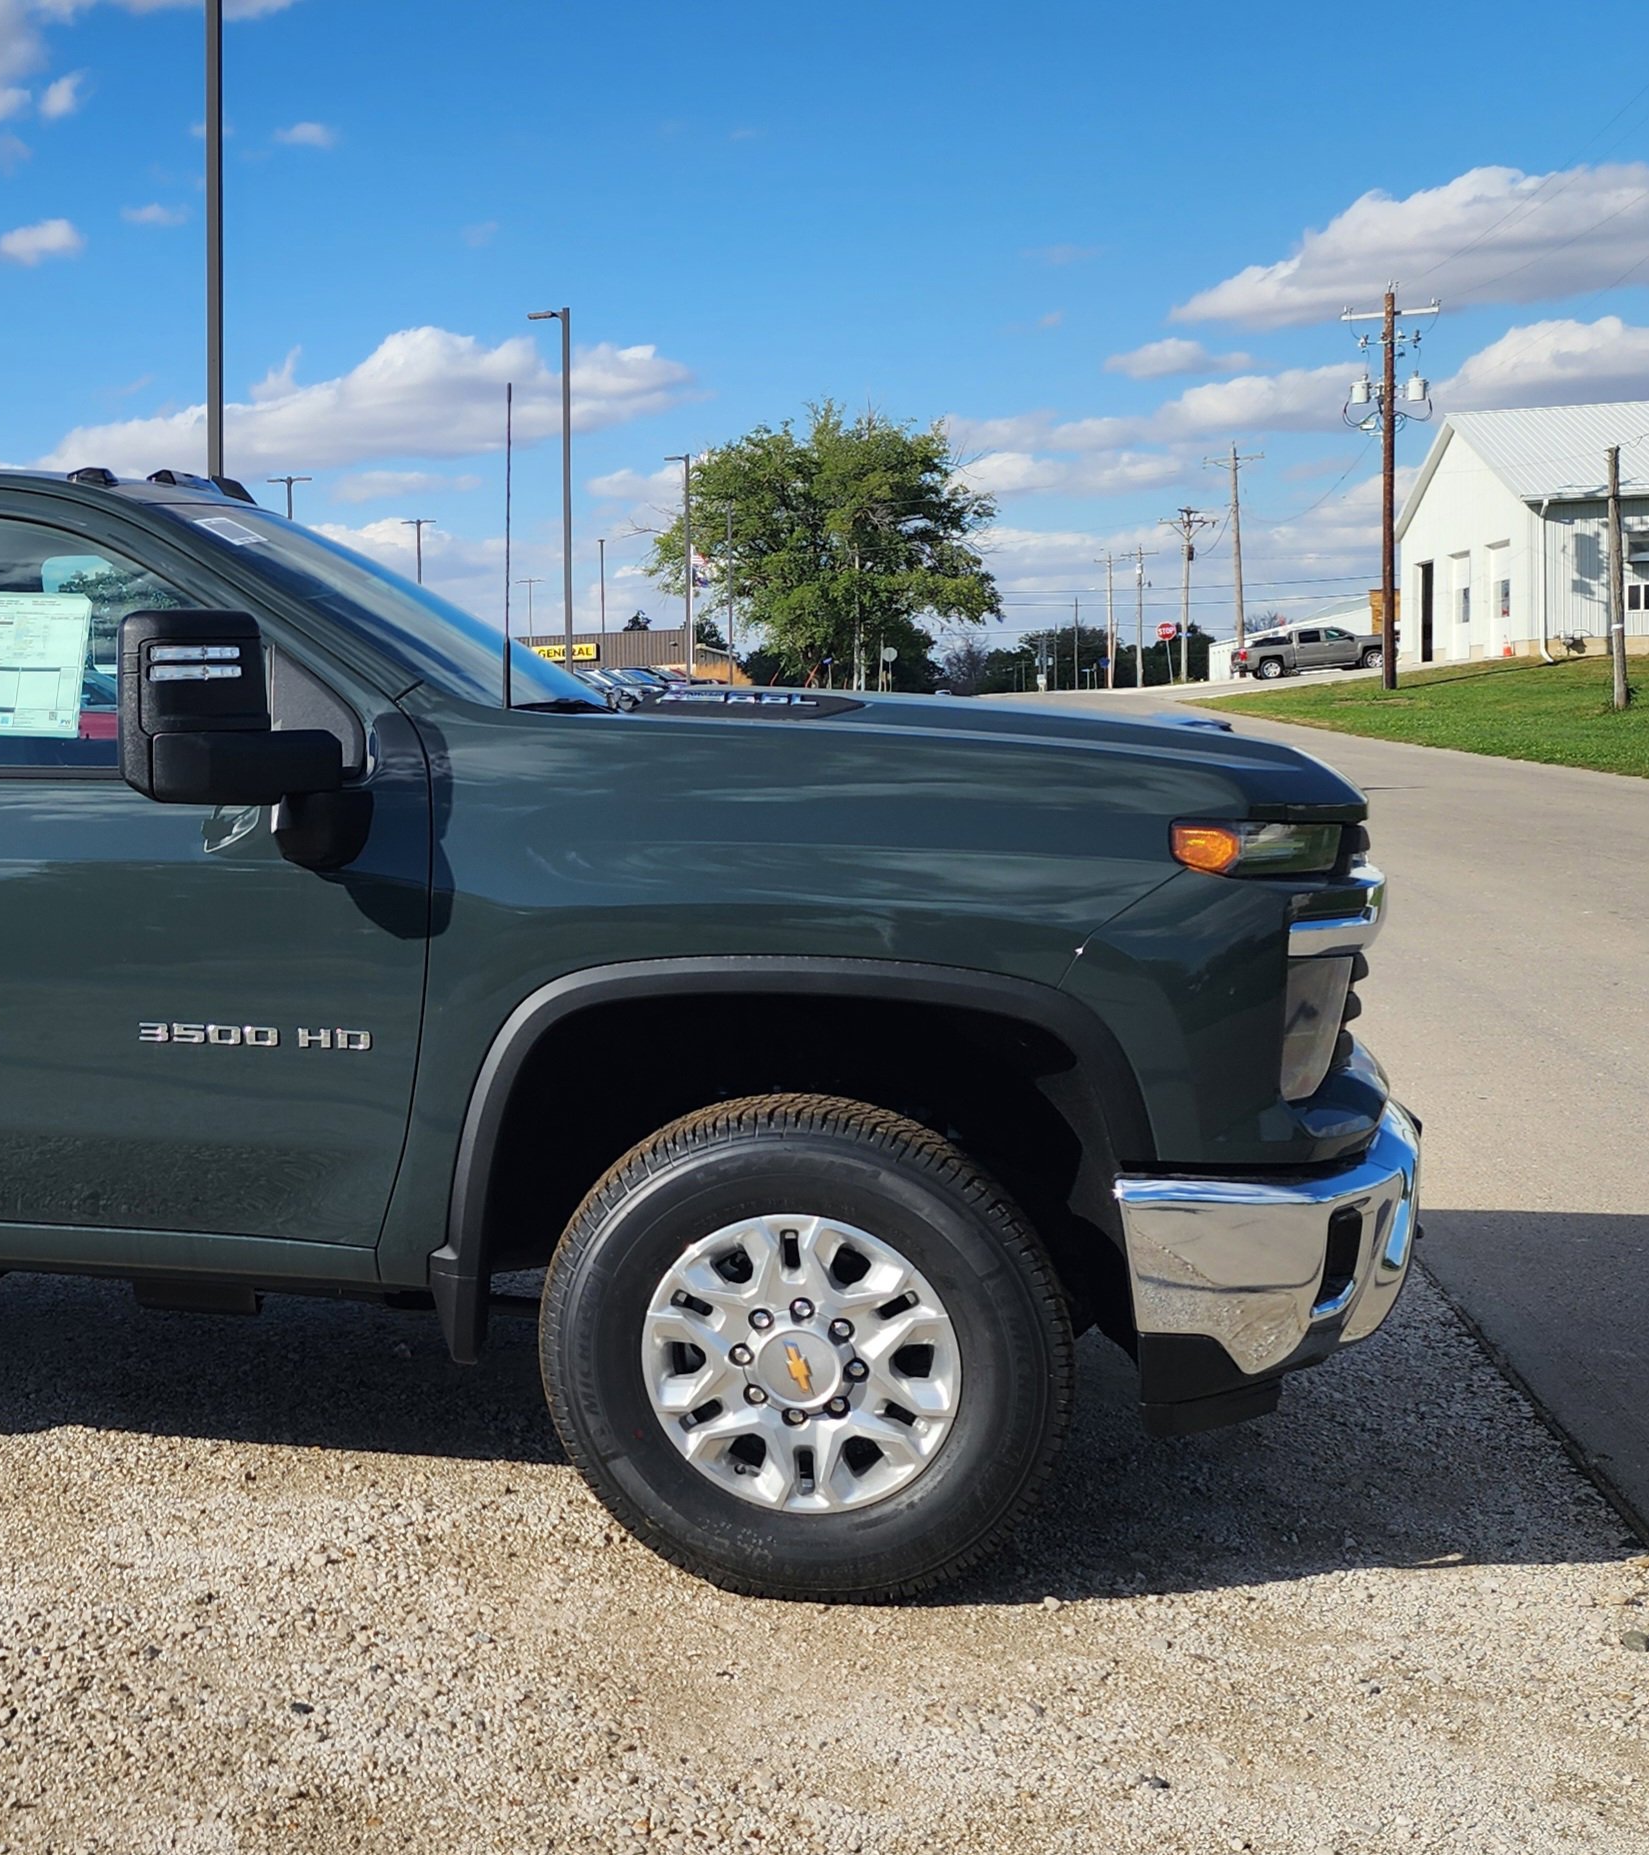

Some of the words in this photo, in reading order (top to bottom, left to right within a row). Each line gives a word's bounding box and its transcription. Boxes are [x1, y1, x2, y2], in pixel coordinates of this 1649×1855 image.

[1158, 626, 1175, 635] STOP
[139, 1022, 279, 1046] 3500
[298, 1028, 371, 1050] HD
